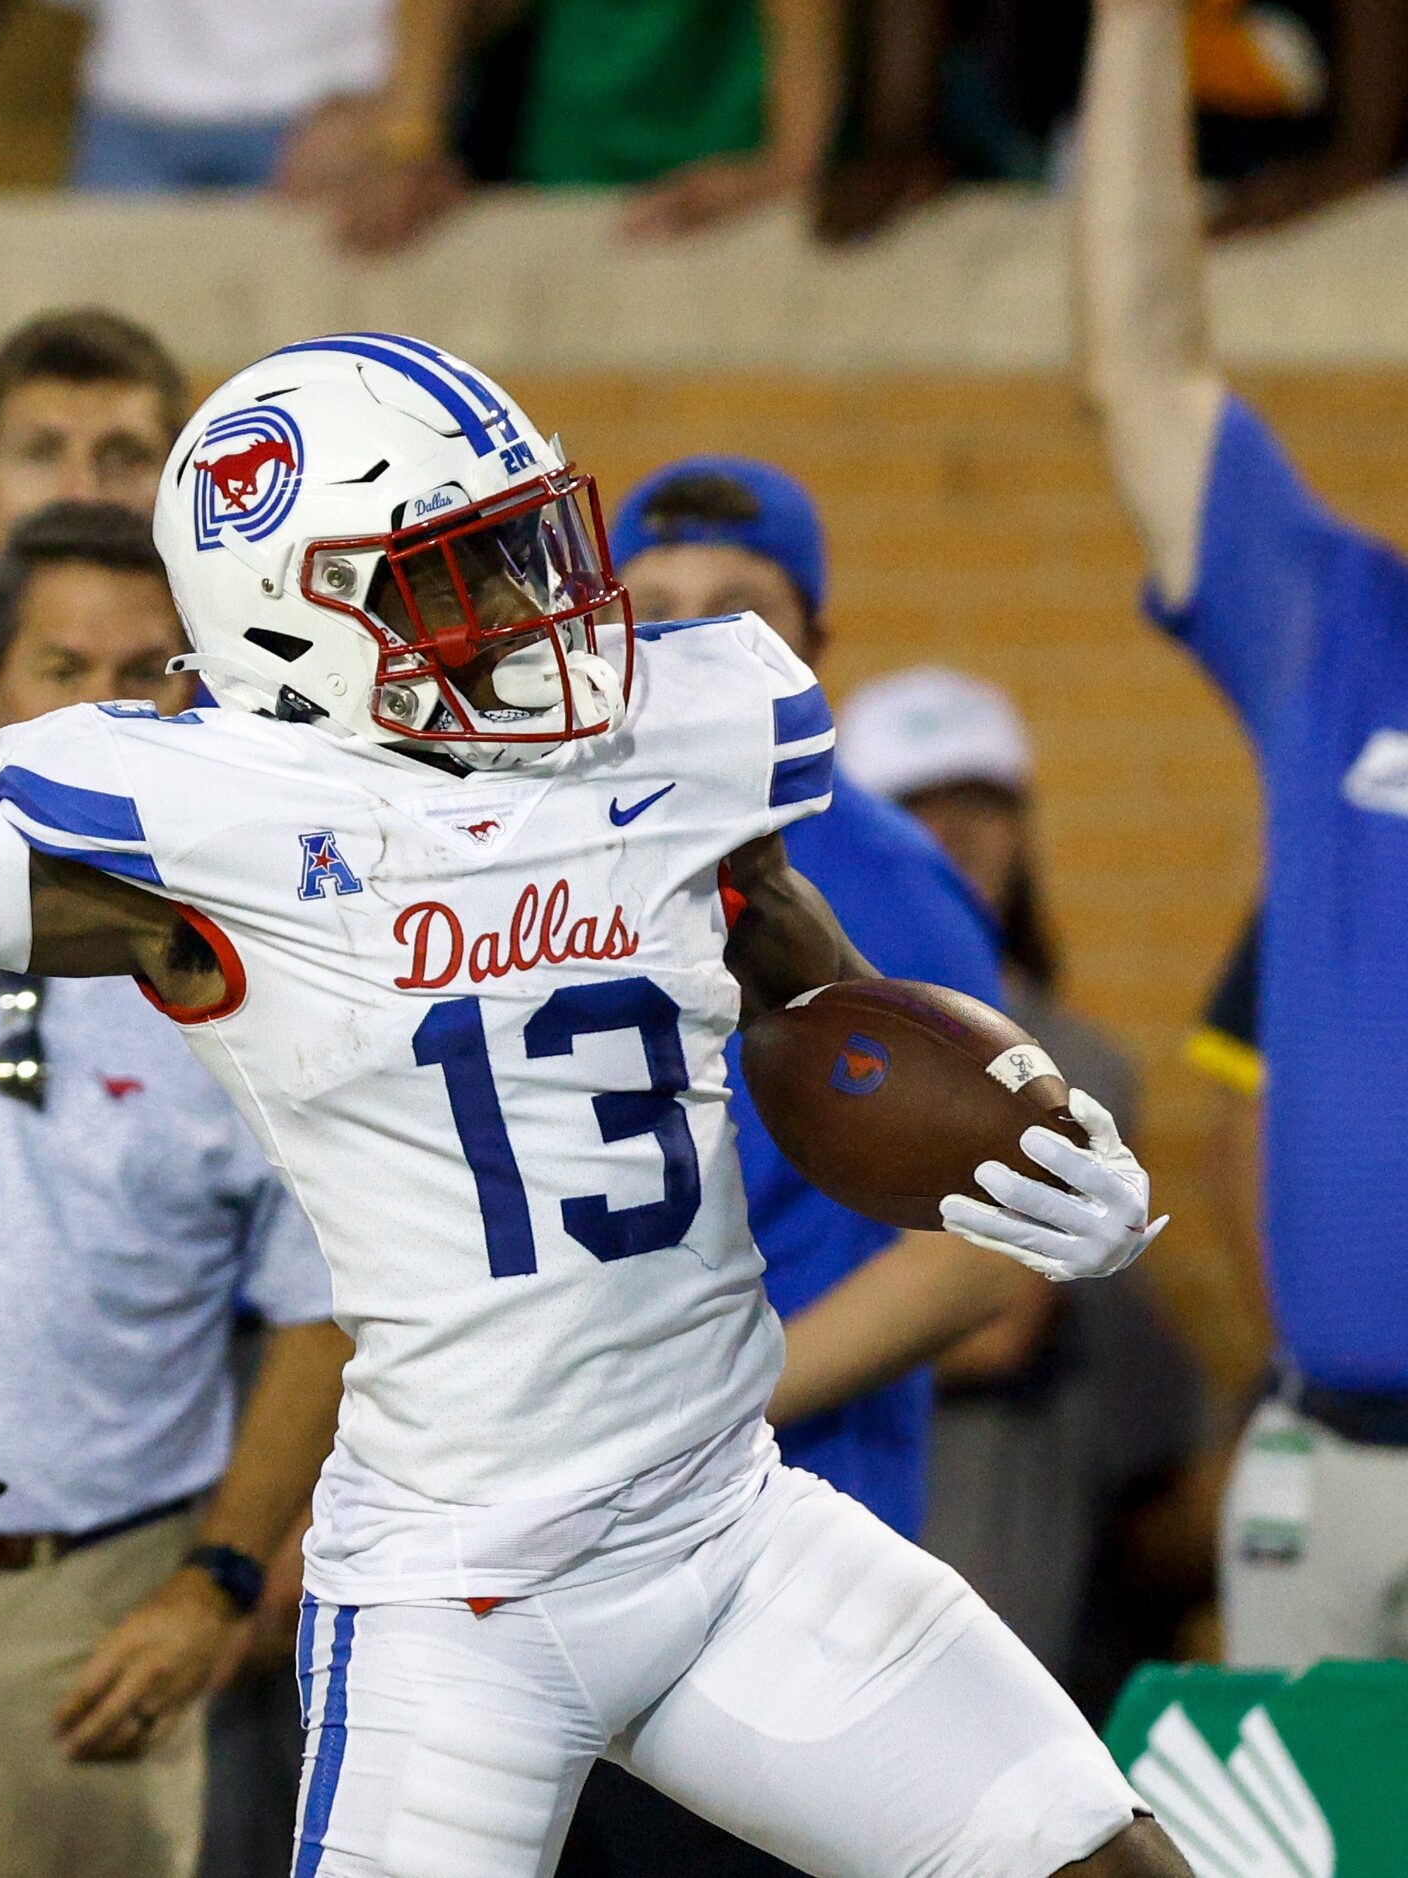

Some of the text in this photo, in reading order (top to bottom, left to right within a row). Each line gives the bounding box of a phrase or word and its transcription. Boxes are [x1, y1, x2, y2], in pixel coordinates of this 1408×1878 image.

[499, 440, 537, 475] 214
[414, 492, 454, 517] Dallas
[393, 879, 640, 989] Dallas
[412, 976, 702, 1278] 13
